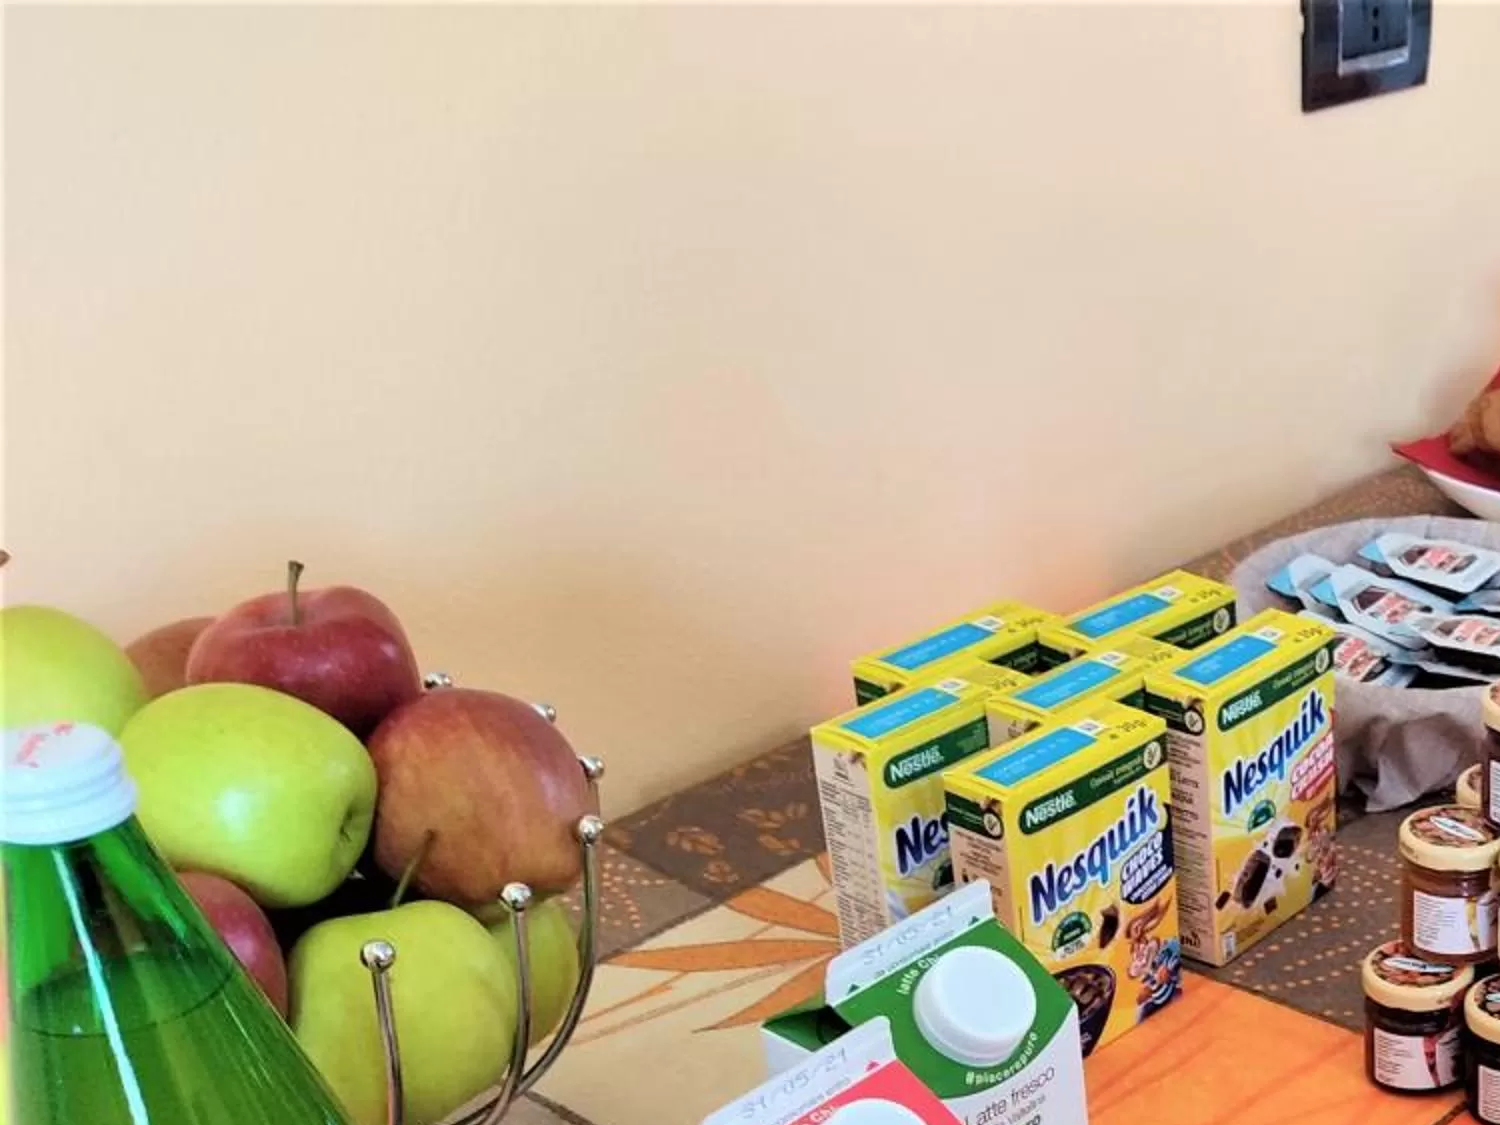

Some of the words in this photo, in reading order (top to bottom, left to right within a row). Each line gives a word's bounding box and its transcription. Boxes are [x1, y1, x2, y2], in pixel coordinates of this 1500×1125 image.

[1222, 690, 1325, 815] Nesquik
[896, 809, 950, 875] Nes
[1030, 786, 1158, 925] Nesquik
[1010, 1066, 1055, 1106] fresco
